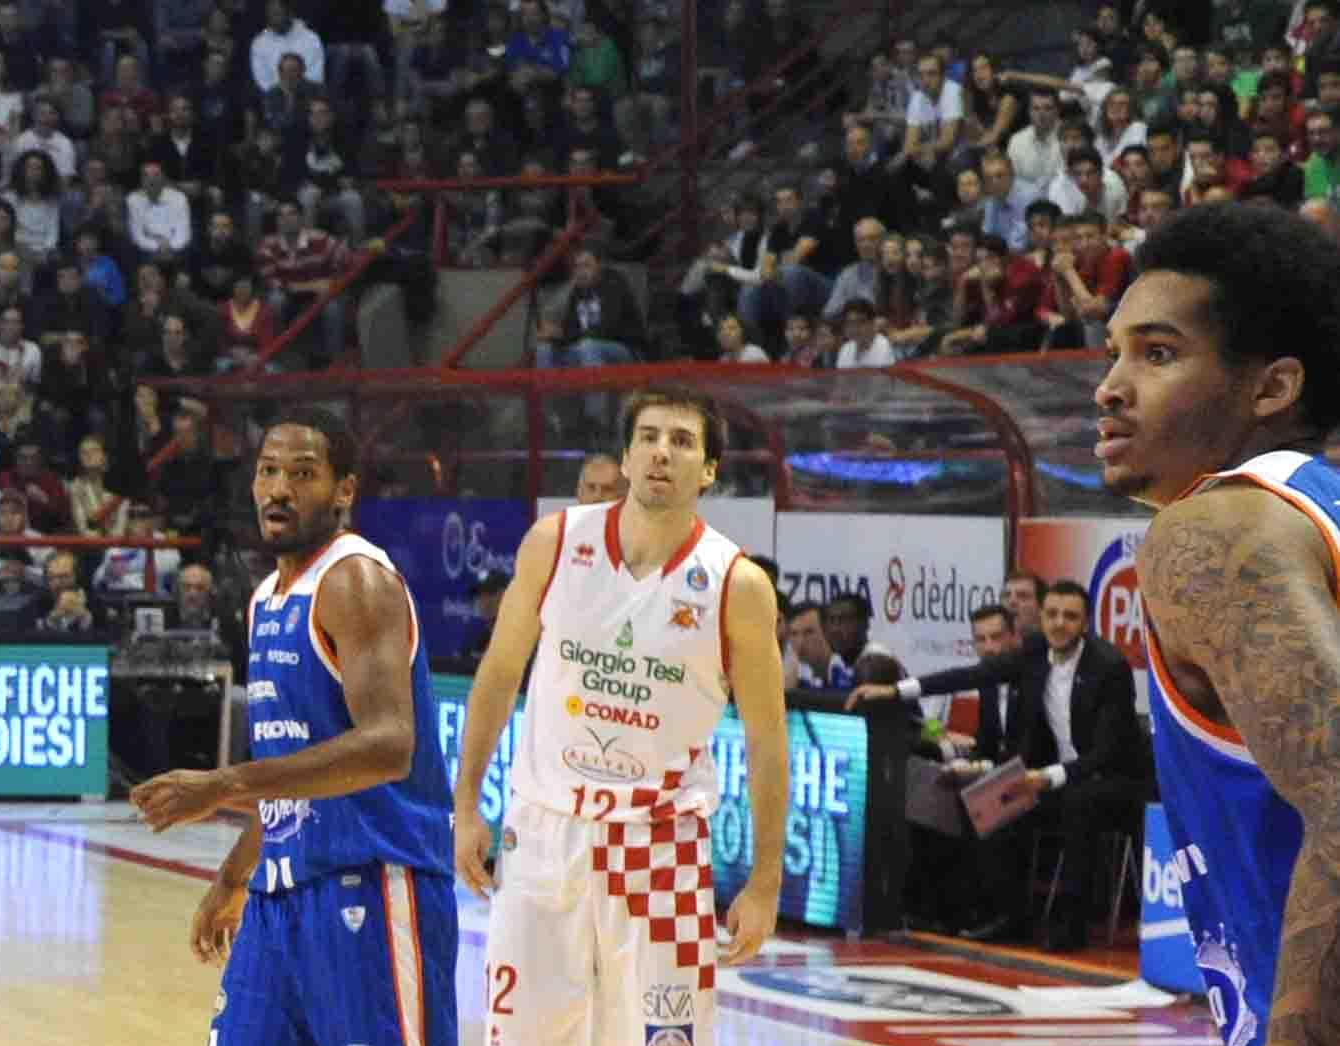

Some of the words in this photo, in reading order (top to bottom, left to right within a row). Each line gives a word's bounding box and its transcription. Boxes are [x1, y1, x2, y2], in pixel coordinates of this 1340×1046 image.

[560, 640, 635, 674] Giorgio
[643, 656, 686, 685] Tesi
[583, 669, 652, 706] Group
[585, 703, 660, 730] CONAD
